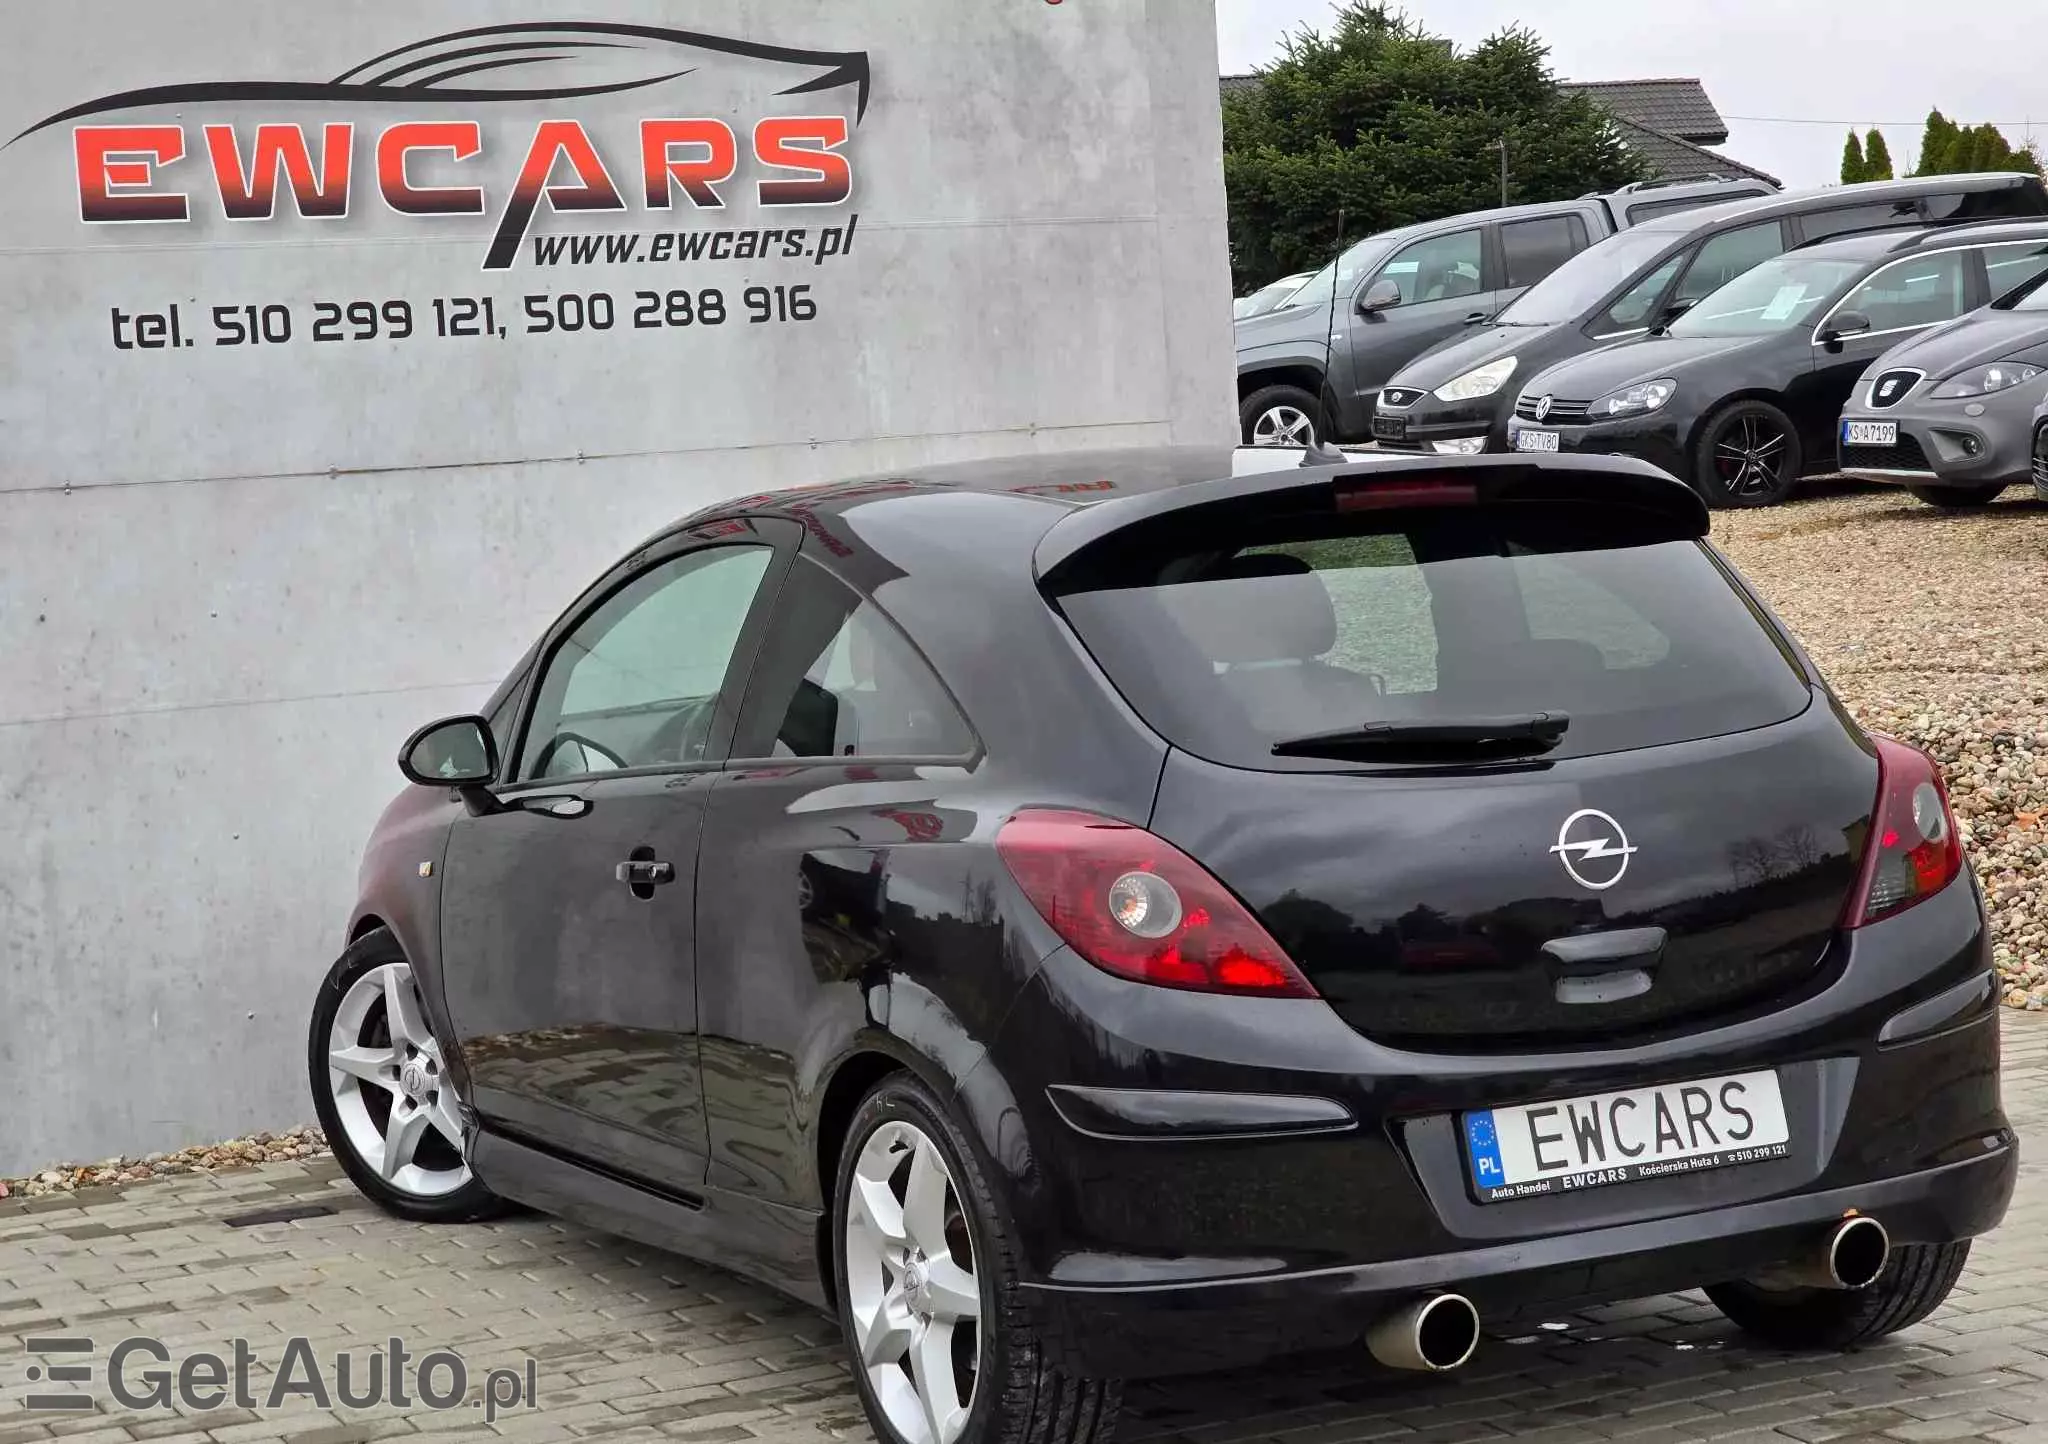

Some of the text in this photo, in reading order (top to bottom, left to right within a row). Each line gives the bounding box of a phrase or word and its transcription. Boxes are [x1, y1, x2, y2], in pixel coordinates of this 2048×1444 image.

[74, 116, 853, 270] EWCARS
[534, 213, 859, 266] www.ewcars.pl
[111, 284, 817, 350] tel. 510 299 121, 500 288 916
[1525, 1081, 1755, 1172] EWCARS
[1478, 1156, 1501, 1177] PL
[1490, 1188, 1515, 1199] Auto
[1515, 1180, 1552, 1195] Handel
[1562, 1167, 1628, 1190] EWCARS
[1689, 1157, 1712, 1169] Huta
[1713, 1154, 1720, 1165] 6
[1736, 1150, 1753, 1162] 510
[1753, 1147, 1770, 1158] 299
[1772, 1144, 1787, 1155] 121
